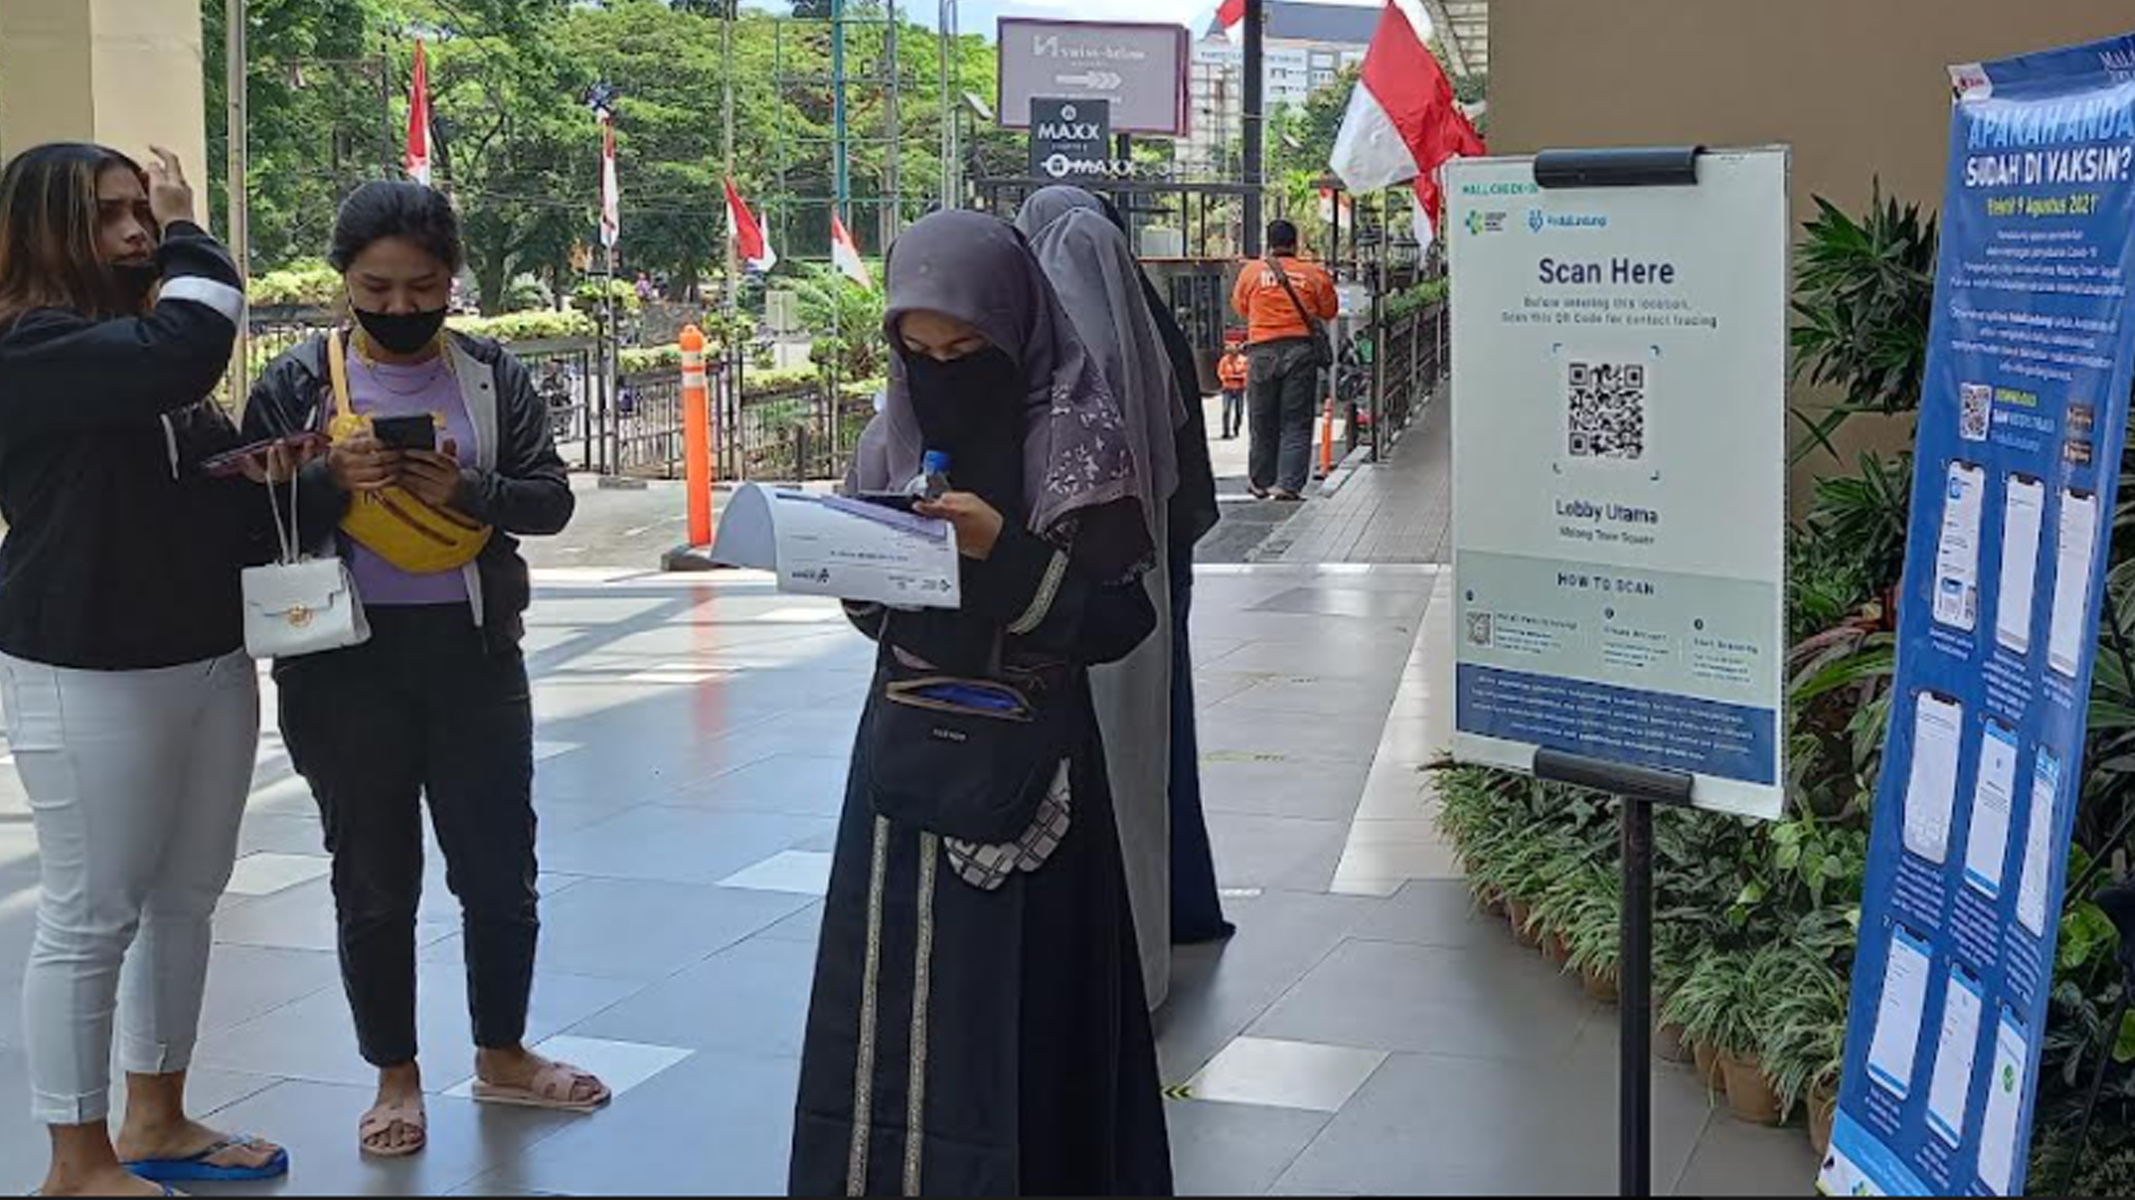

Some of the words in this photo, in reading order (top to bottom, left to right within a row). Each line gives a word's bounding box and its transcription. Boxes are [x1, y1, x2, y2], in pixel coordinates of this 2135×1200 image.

[1037, 123, 1100, 140] MAXX
[1967, 105, 2058, 149] APAKAH
[2062, 94, 2134, 141] ANDA
[1965, 152, 2020, 187] SUDAH
[2024, 149, 2041, 184] DI
[2046, 145, 2132, 184] VAKSIN?
[1538, 258, 1601, 284] Scan
[1611, 258, 1675, 284] Here
[1613, 298, 1636, 309] this
[1501, 310, 1528, 323] Scan
[1555, 312, 1571, 325] QR
[1574, 312, 1603, 325] Code
[1605, 314, 1623, 326] for
[1555, 499, 1602, 524] Lobby
[1605, 504, 1660, 525] Utama
[1556, 572, 1589, 589] HOW
[1592, 575, 1613, 592] TO
[1615, 577, 1655, 596] SCAN
